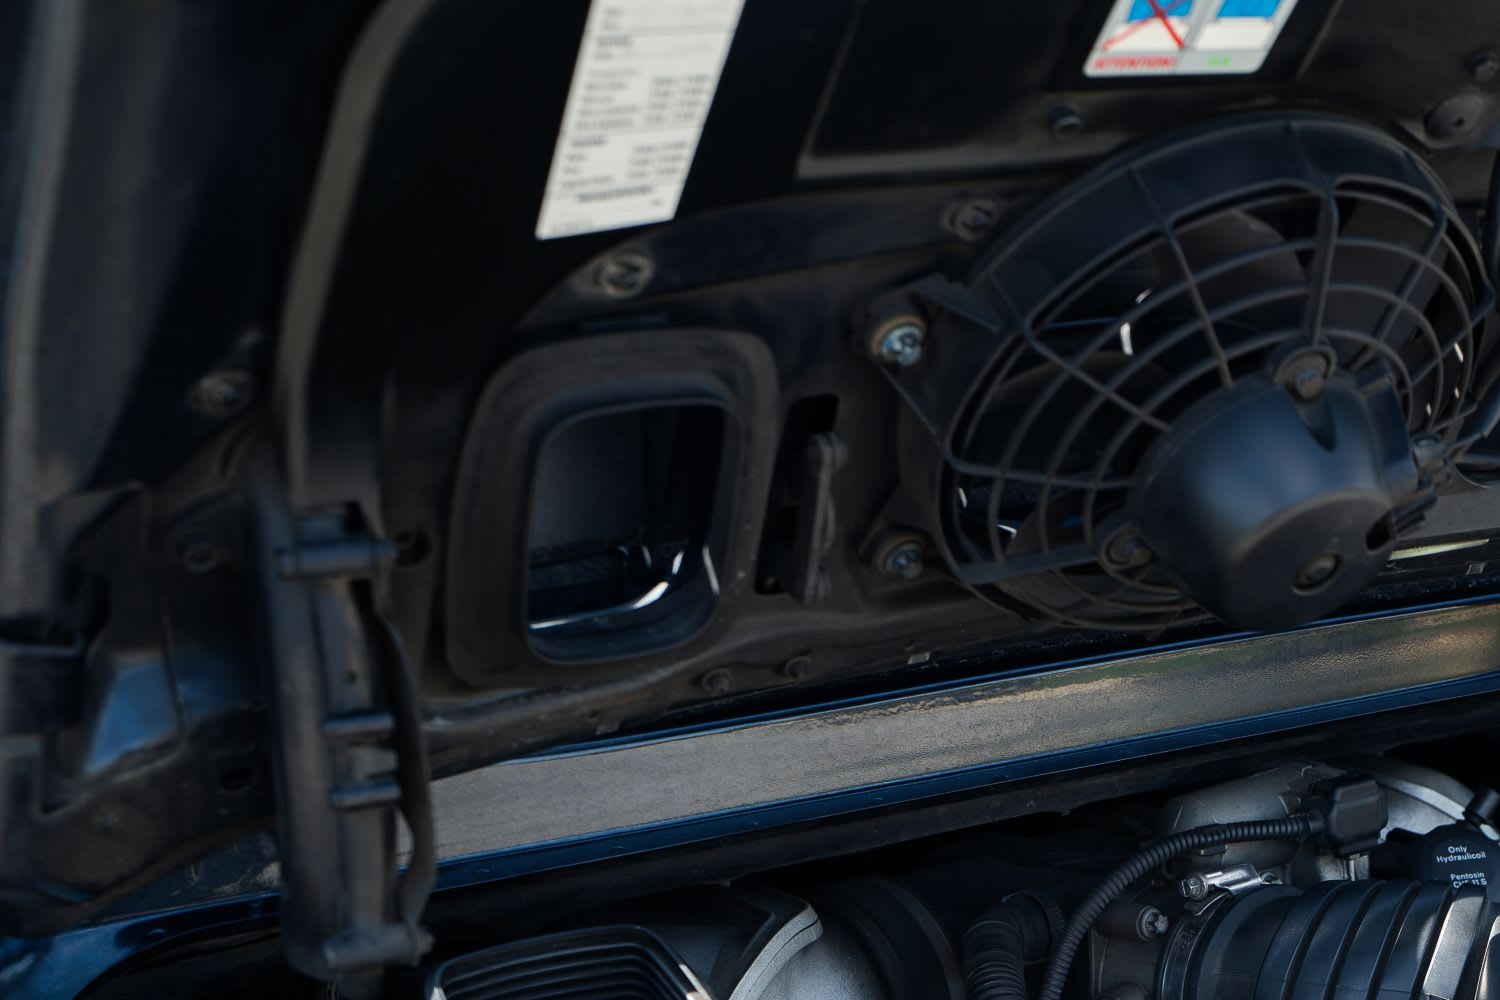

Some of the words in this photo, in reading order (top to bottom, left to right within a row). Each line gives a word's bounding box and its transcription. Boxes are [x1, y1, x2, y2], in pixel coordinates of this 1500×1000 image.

[1448, 845, 1467, 854] Only
[1436, 851, 1486, 863] Hydraulicoil
[1450, 871, 1485, 881] Pentosin
[1480, 878, 1488, 886] S
